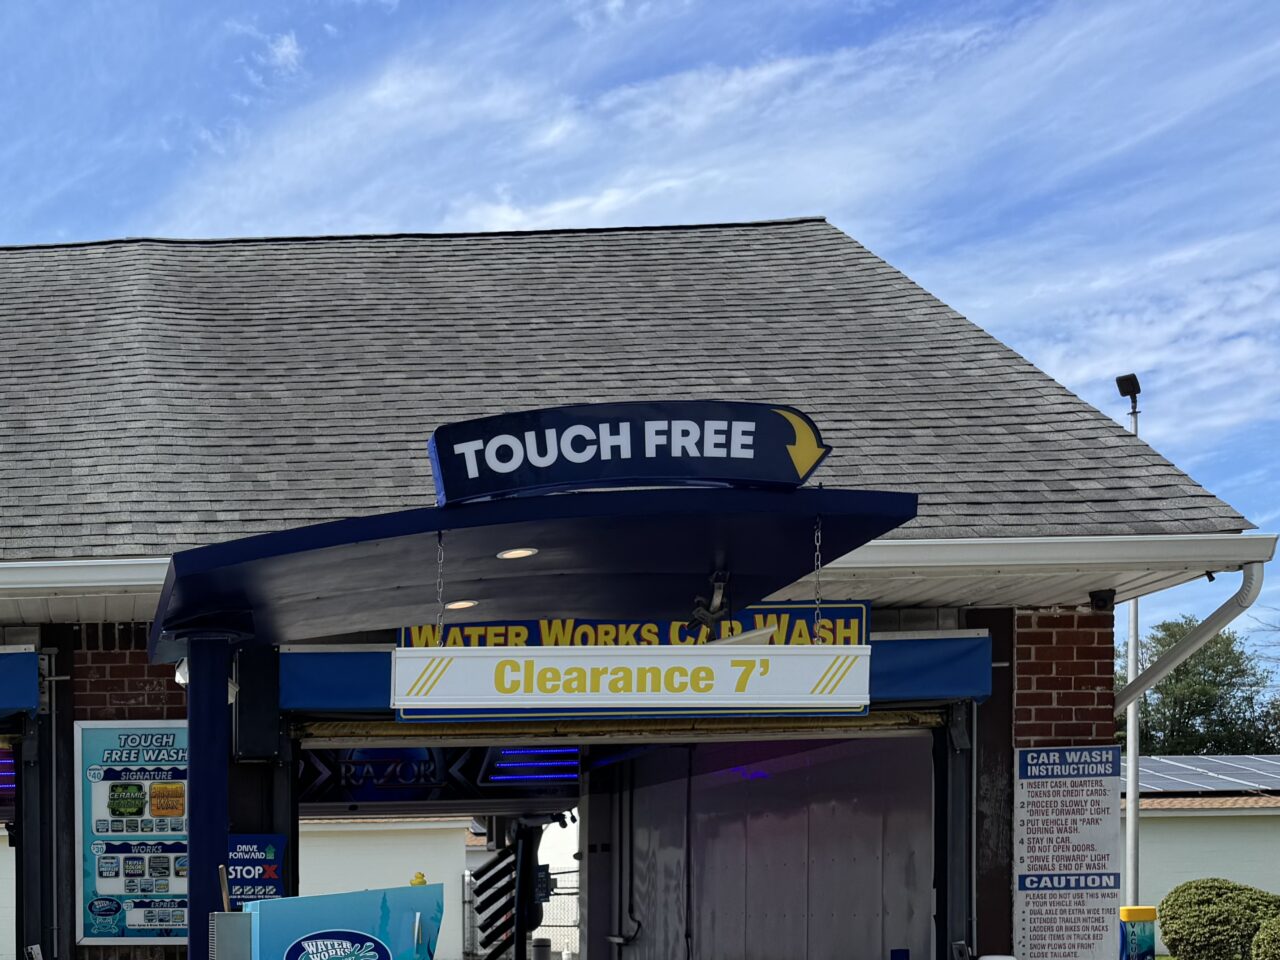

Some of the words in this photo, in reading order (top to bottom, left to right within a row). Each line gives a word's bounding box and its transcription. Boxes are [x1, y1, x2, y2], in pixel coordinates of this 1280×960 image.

[454, 422, 632, 478] TOUCH
[645, 420, 756, 458] FREE
[540, 619, 659, 646] WORKS
[494, 659, 714, 694] Clearance
[119, 734, 175, 747] TOUCH
[102, 749, 139, 762] FREE
[143, 748, 187, 762] WASH
[1027, 752, 1060, 764] CAR
[1066, 750, 1113, 763] WASH
[120, 771, 173, 780] SIGNATURE
[1027, 763, 1113, 776] INSTRUCTIONS
[1027, 781, 1048, 789] INSERT
[1027, 790, 1050, 798] TOKENS
[1027, 837, 1044, 845] STAY
[1038, 845, 1051, 853] NOT
[228, 866, 263, 878] STOP
[1027, 863, 1055, 871] SIGNALS
[1059, 863, 1072, 871] END
[1075, 862, 1084, 870] OF
[1025, 875, 1114, 888] CAUTION
[301, 940, 352, 954] WATER
